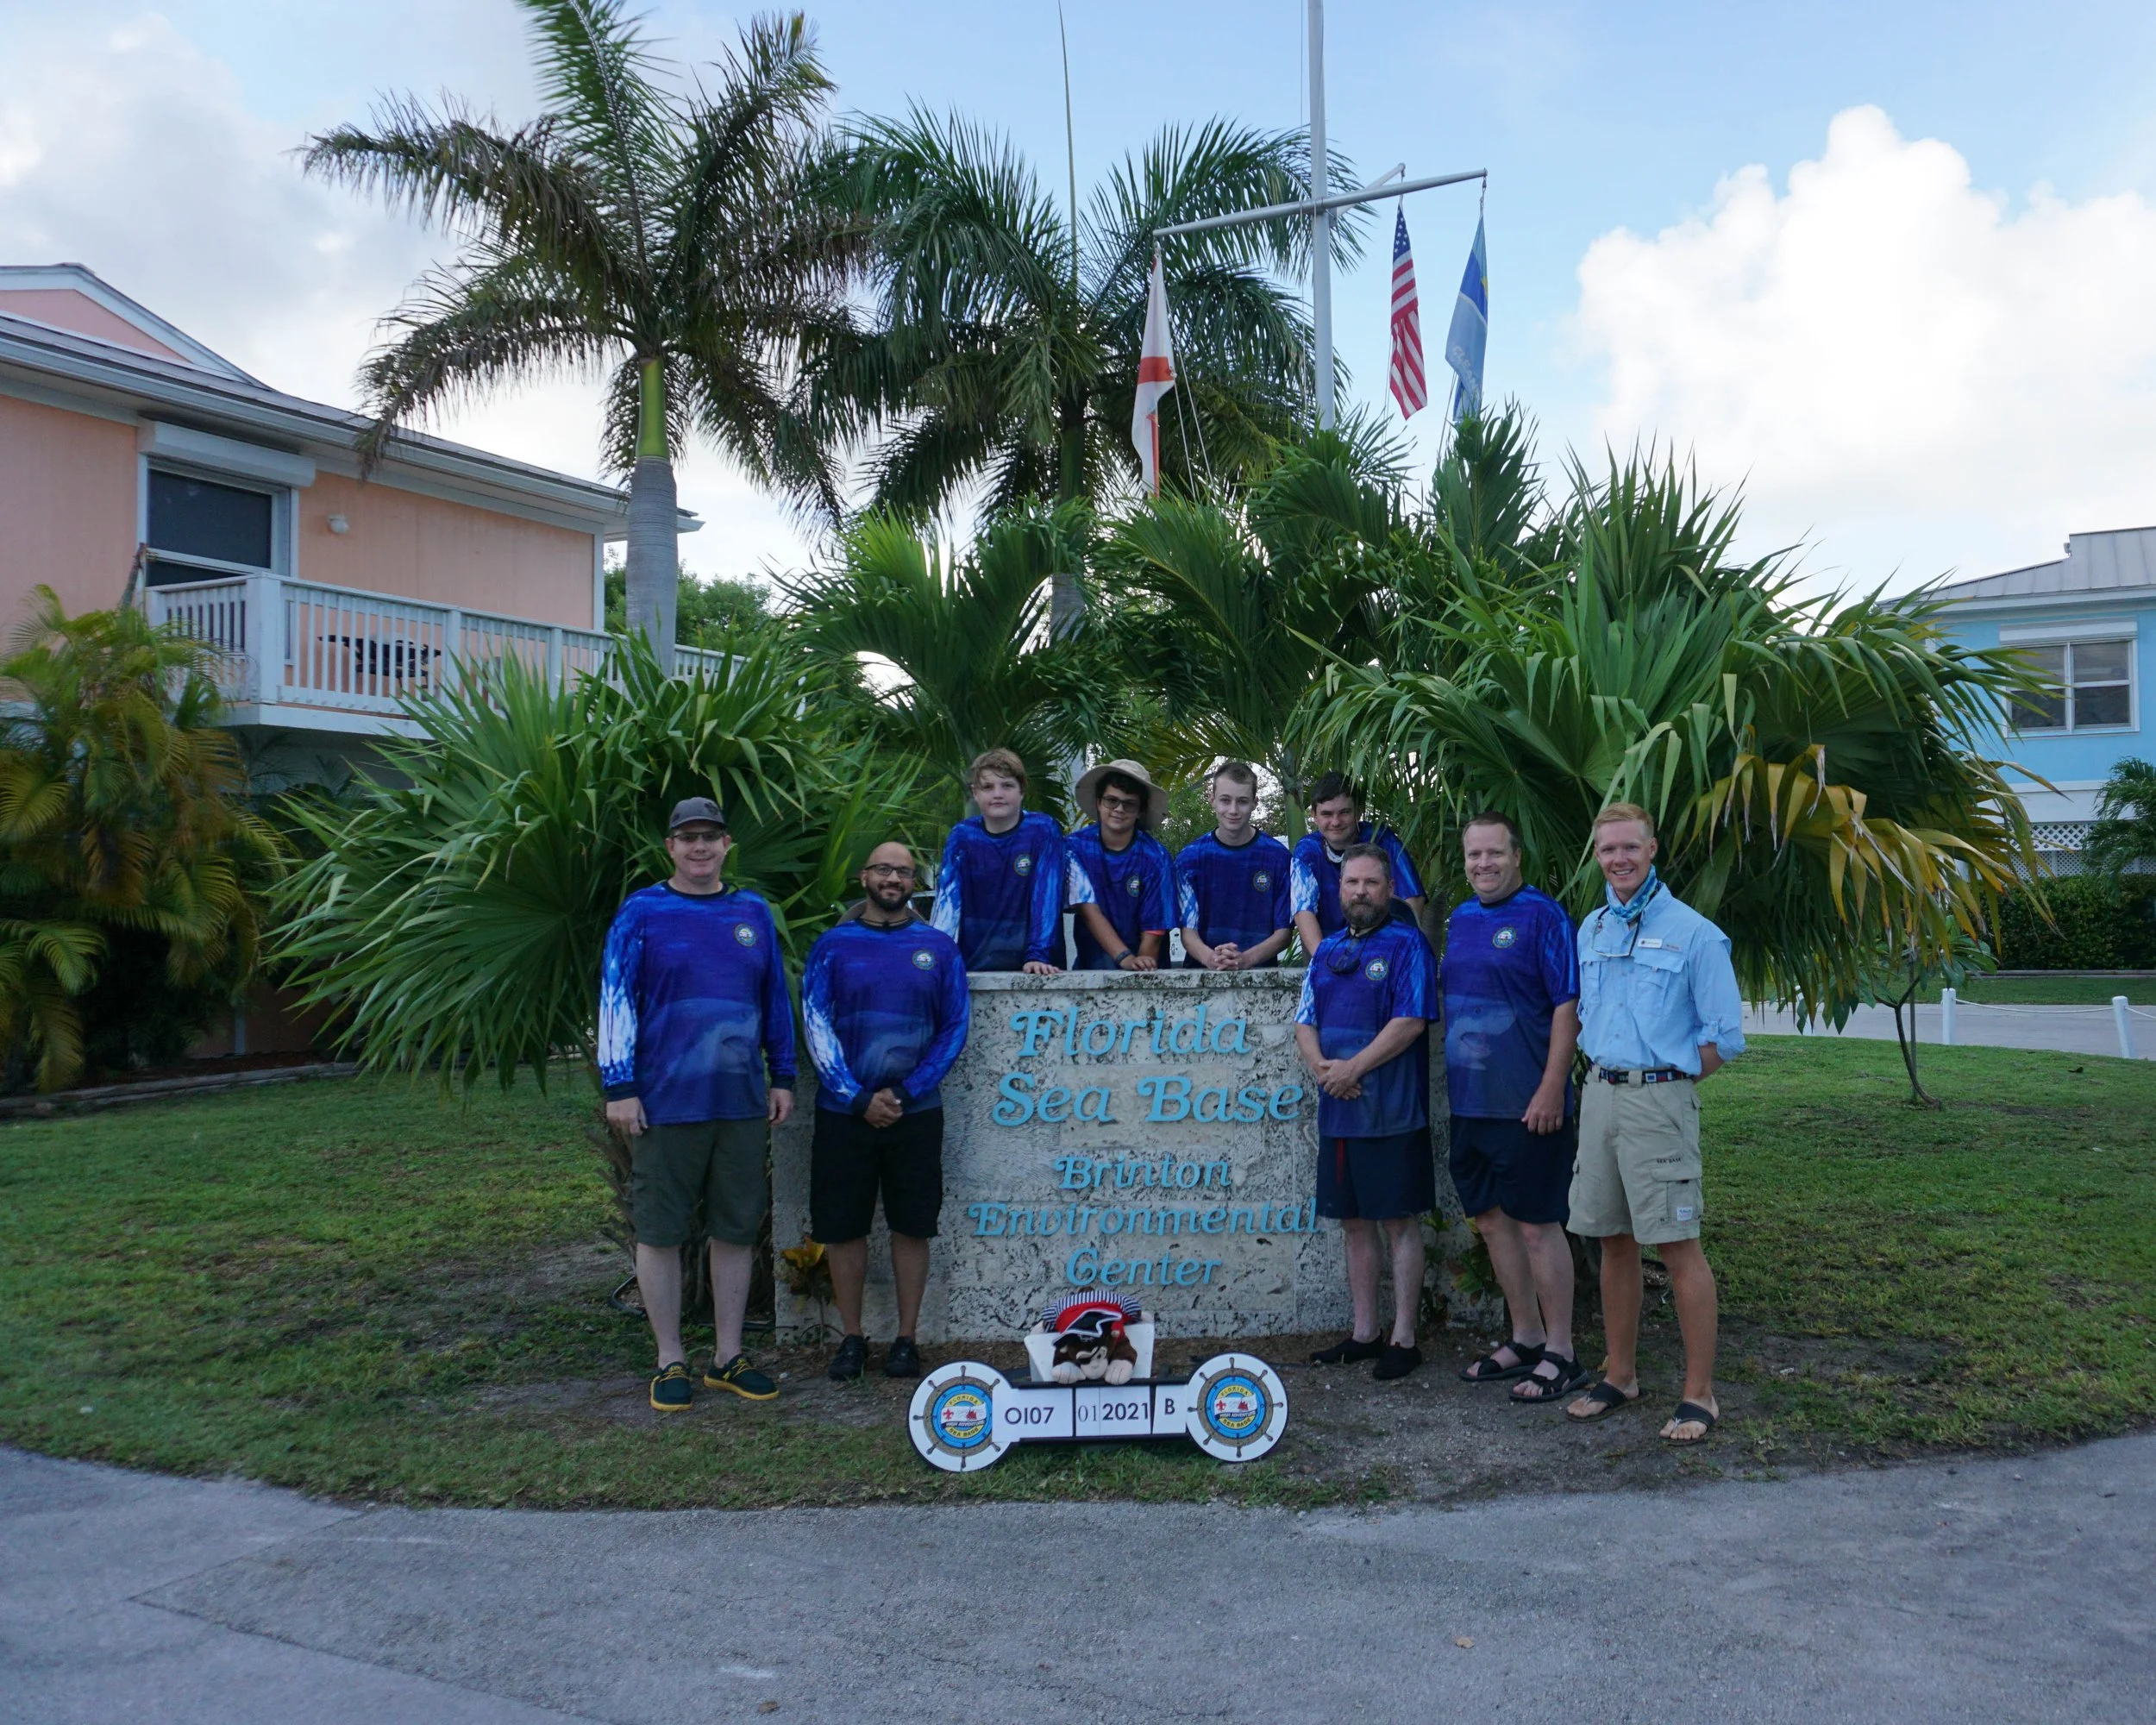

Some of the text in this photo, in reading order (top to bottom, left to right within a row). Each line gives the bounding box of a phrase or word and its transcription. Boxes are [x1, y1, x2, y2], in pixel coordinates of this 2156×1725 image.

[1009, 1004, 1252, 1058] Florida
[991, 1071, 1304, 1127] Sea Base
[1053, 1154, 1232, 1190] Brinton
[968, 1196, 1320, 1236] Environmental
[1065, 1247, 1222, 1287] Center
[949, 1396, 978, 1405] FLORIDA
[1102, 1402, 1149, 1421] 2021
[1164, 1398, 1175, 1415] B
[1220, 1387, 1248, 1396] FLORIDA
